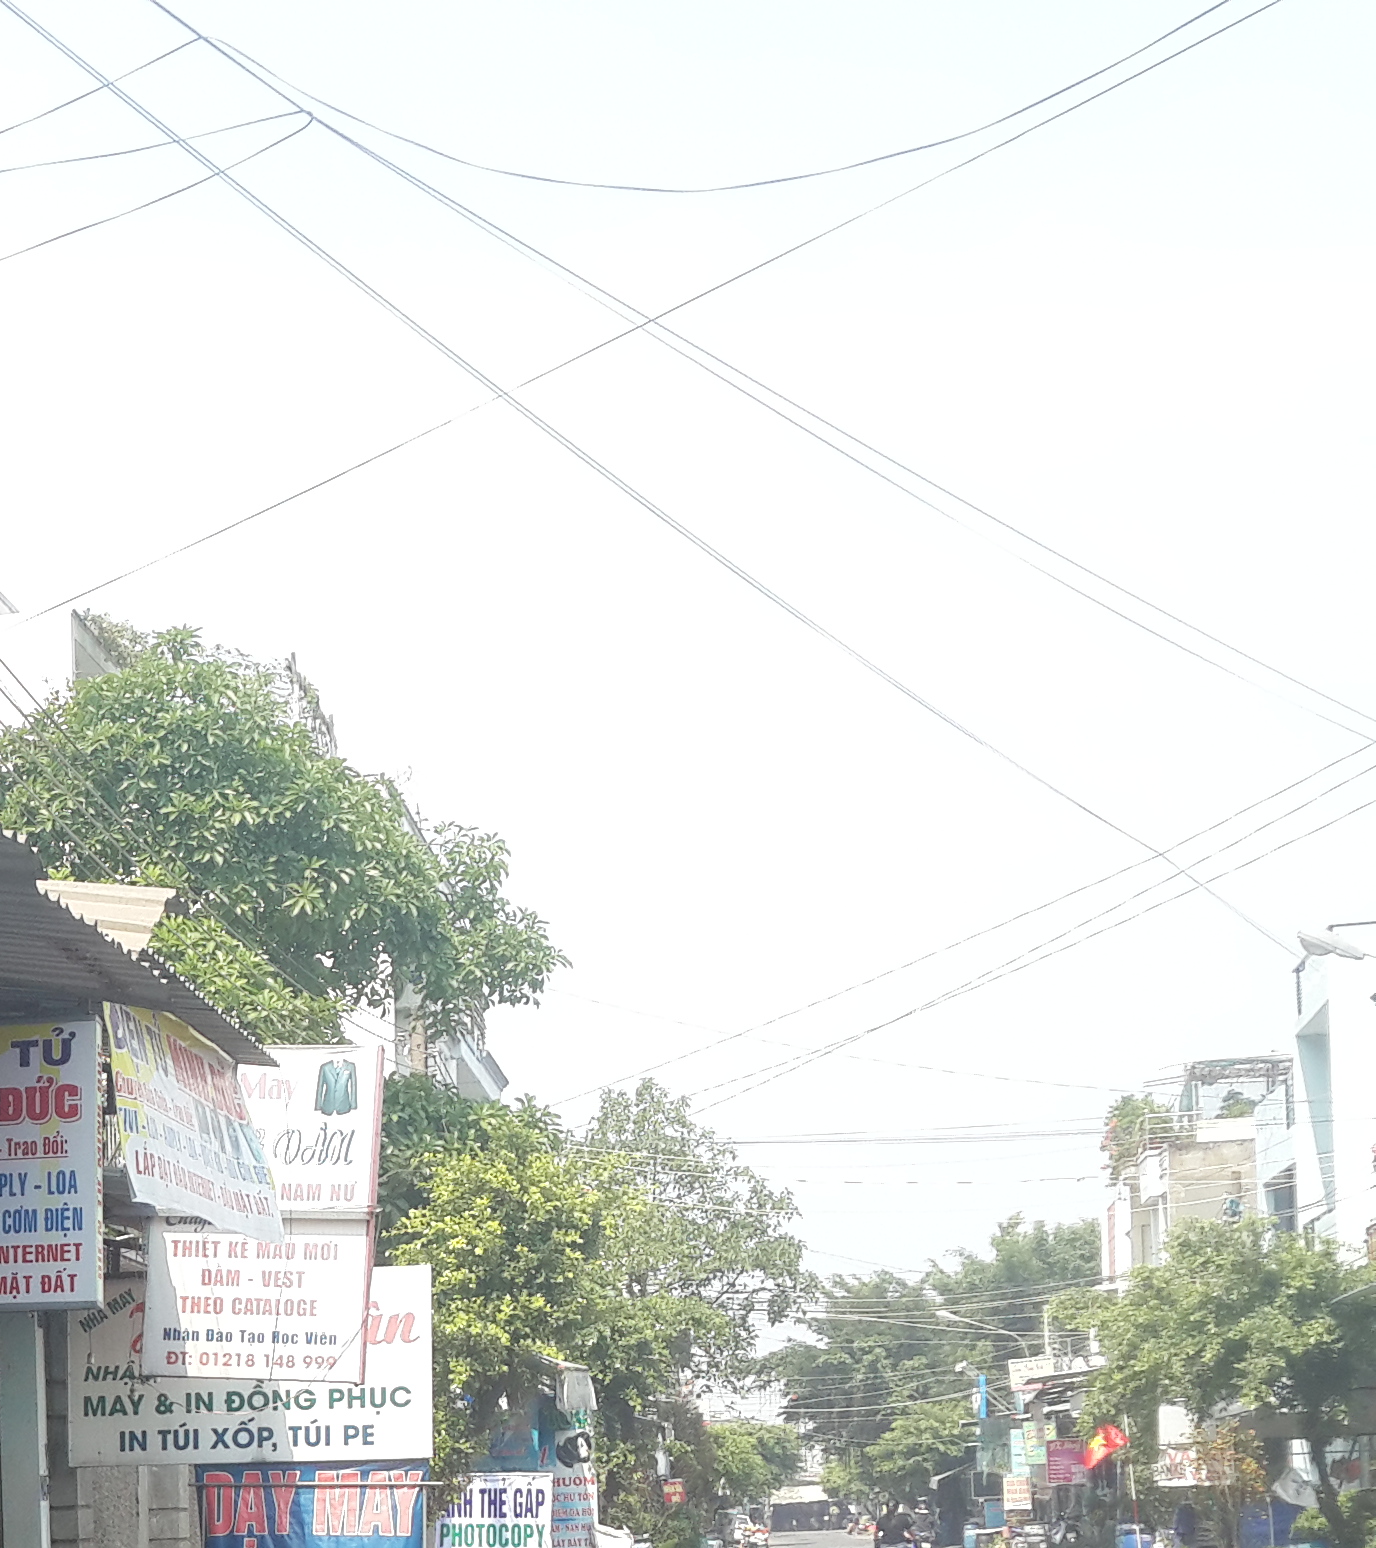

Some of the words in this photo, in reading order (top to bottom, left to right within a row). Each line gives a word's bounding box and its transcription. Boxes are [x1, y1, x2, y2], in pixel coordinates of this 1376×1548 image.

[10, 1026, 77, 1068] TỬ
[5, 1138, 38, 1158] Trao
[47, 1169, 78, 1196] LOA
[280, 1182, 322, 1202] NAM
[1, 1204, 38, 1235] CƠM
[43, 1202, 84, 1238] ĐIỆN
[40, 1267, 78, 1294] ĐẤT
[261, 1269, 306, 1289] VEST
[179, 1295, 224, 1316] THEO
[231, 1296, 319, 1318] CATALOGE
[198, 1351, 256, 1368] 01218
[263, 1353, 296, 1369] 148
[302, 1355, 337, 1371] 999
[154, 1393, 175, 1415] &
[185, 1391, 215, 1414] IN
[224, 1379, 316, 1413] ĐỒNG
[328, 1385, 412, 1416] PHỤC
[119, 1430, 147, 1453] IN
[157, 1422, 199, 1451] TÚI
[209, 1416, 279, 1452] XỐP,
[287, 1418, 332, 1447] TÚI
[343, 1424, 376, 1447] PE
[311, 1470, 424, 1537] MAY
[439, 1522, 547, 1548] PHOTOCOPY
